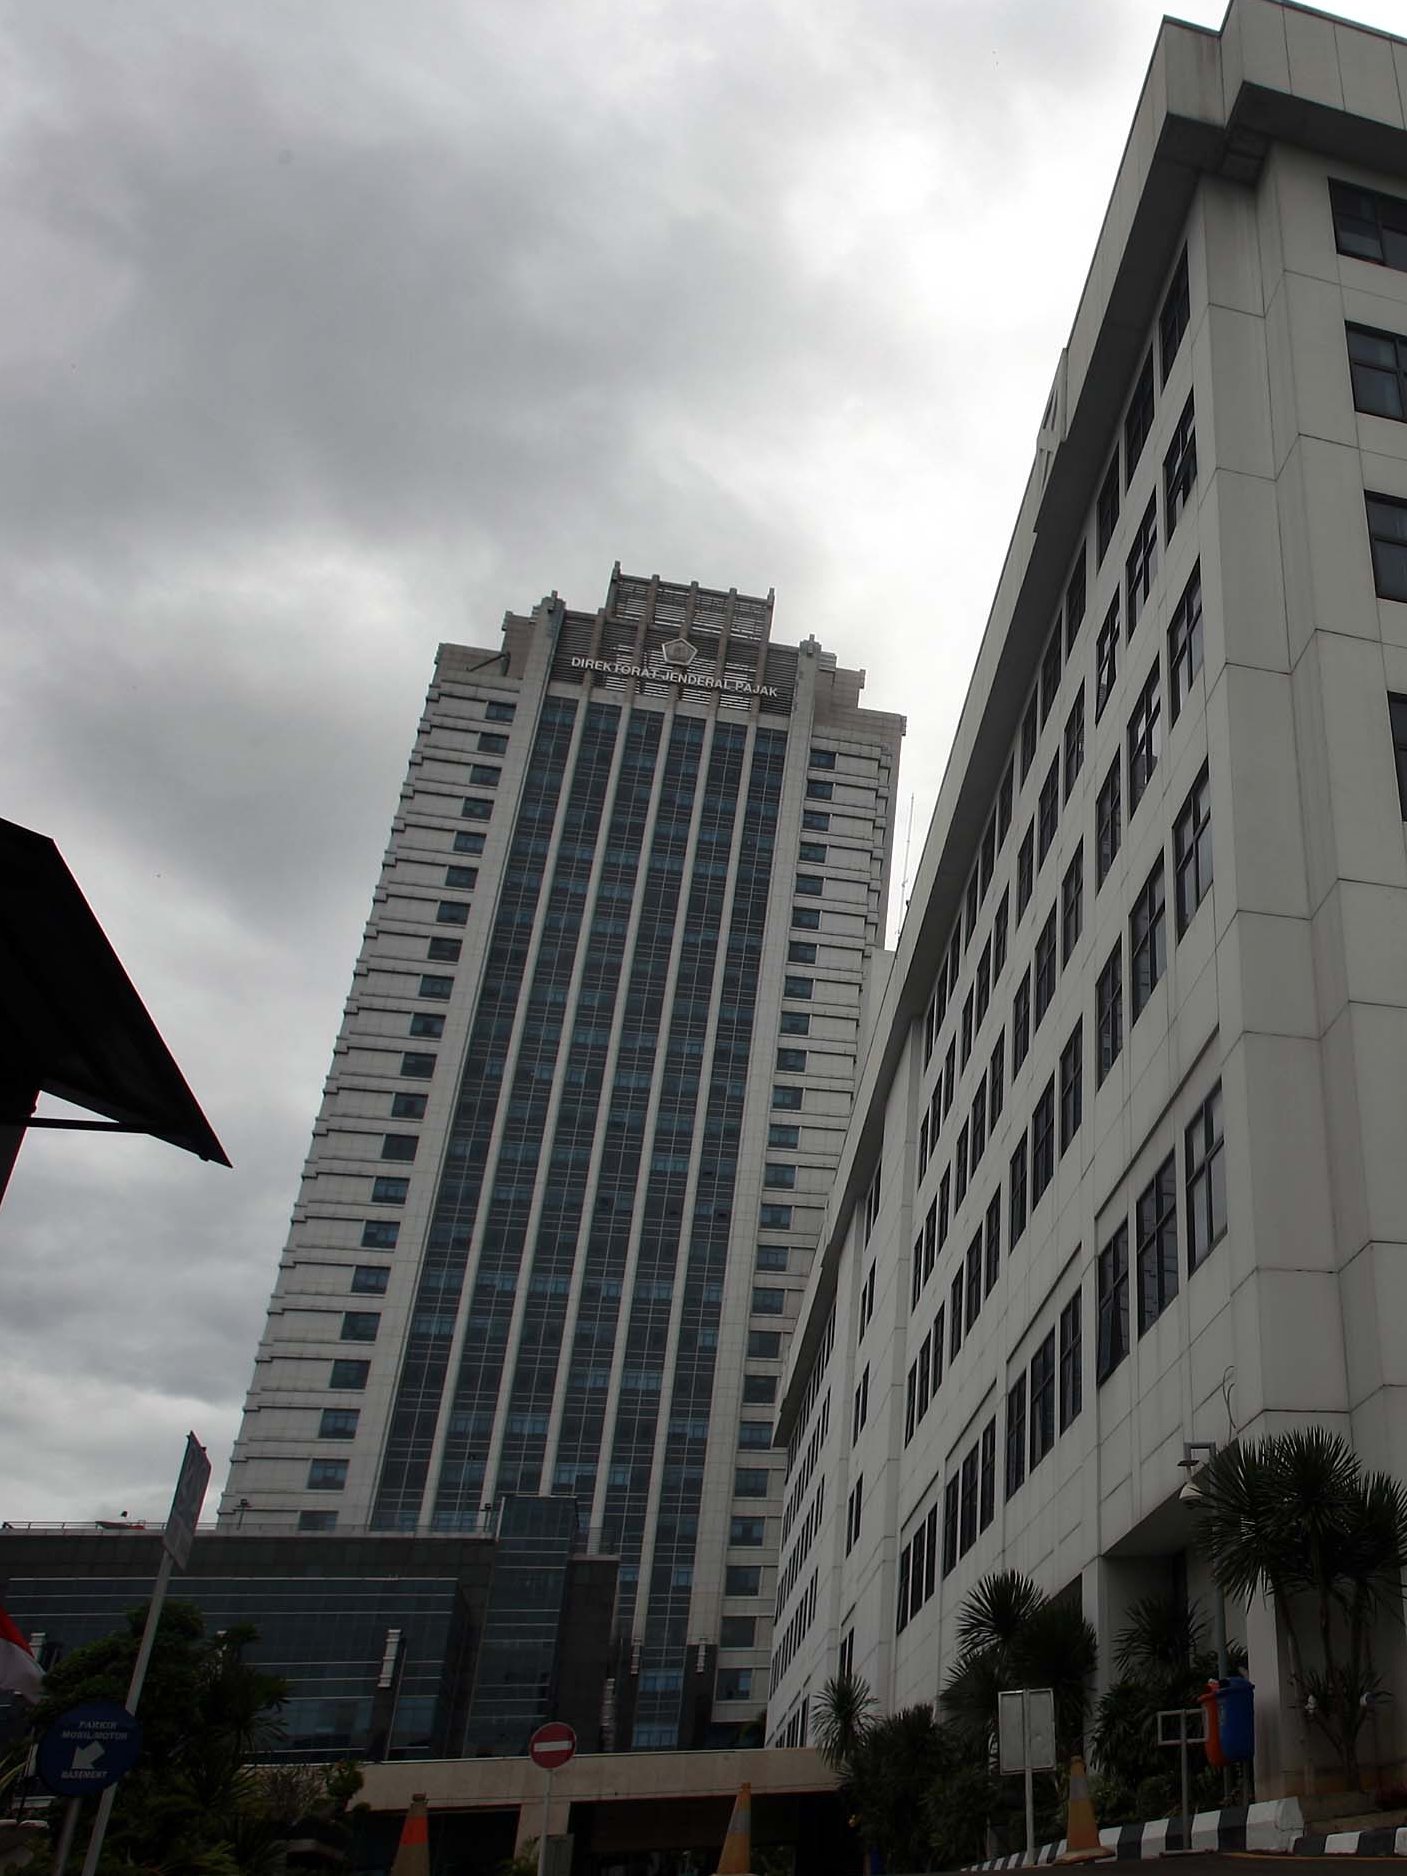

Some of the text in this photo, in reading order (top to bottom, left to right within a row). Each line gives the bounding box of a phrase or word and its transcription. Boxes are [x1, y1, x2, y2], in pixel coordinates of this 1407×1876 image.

[571, 656, 779, 698] DIREKTORAT JENDERAL PAJAK
